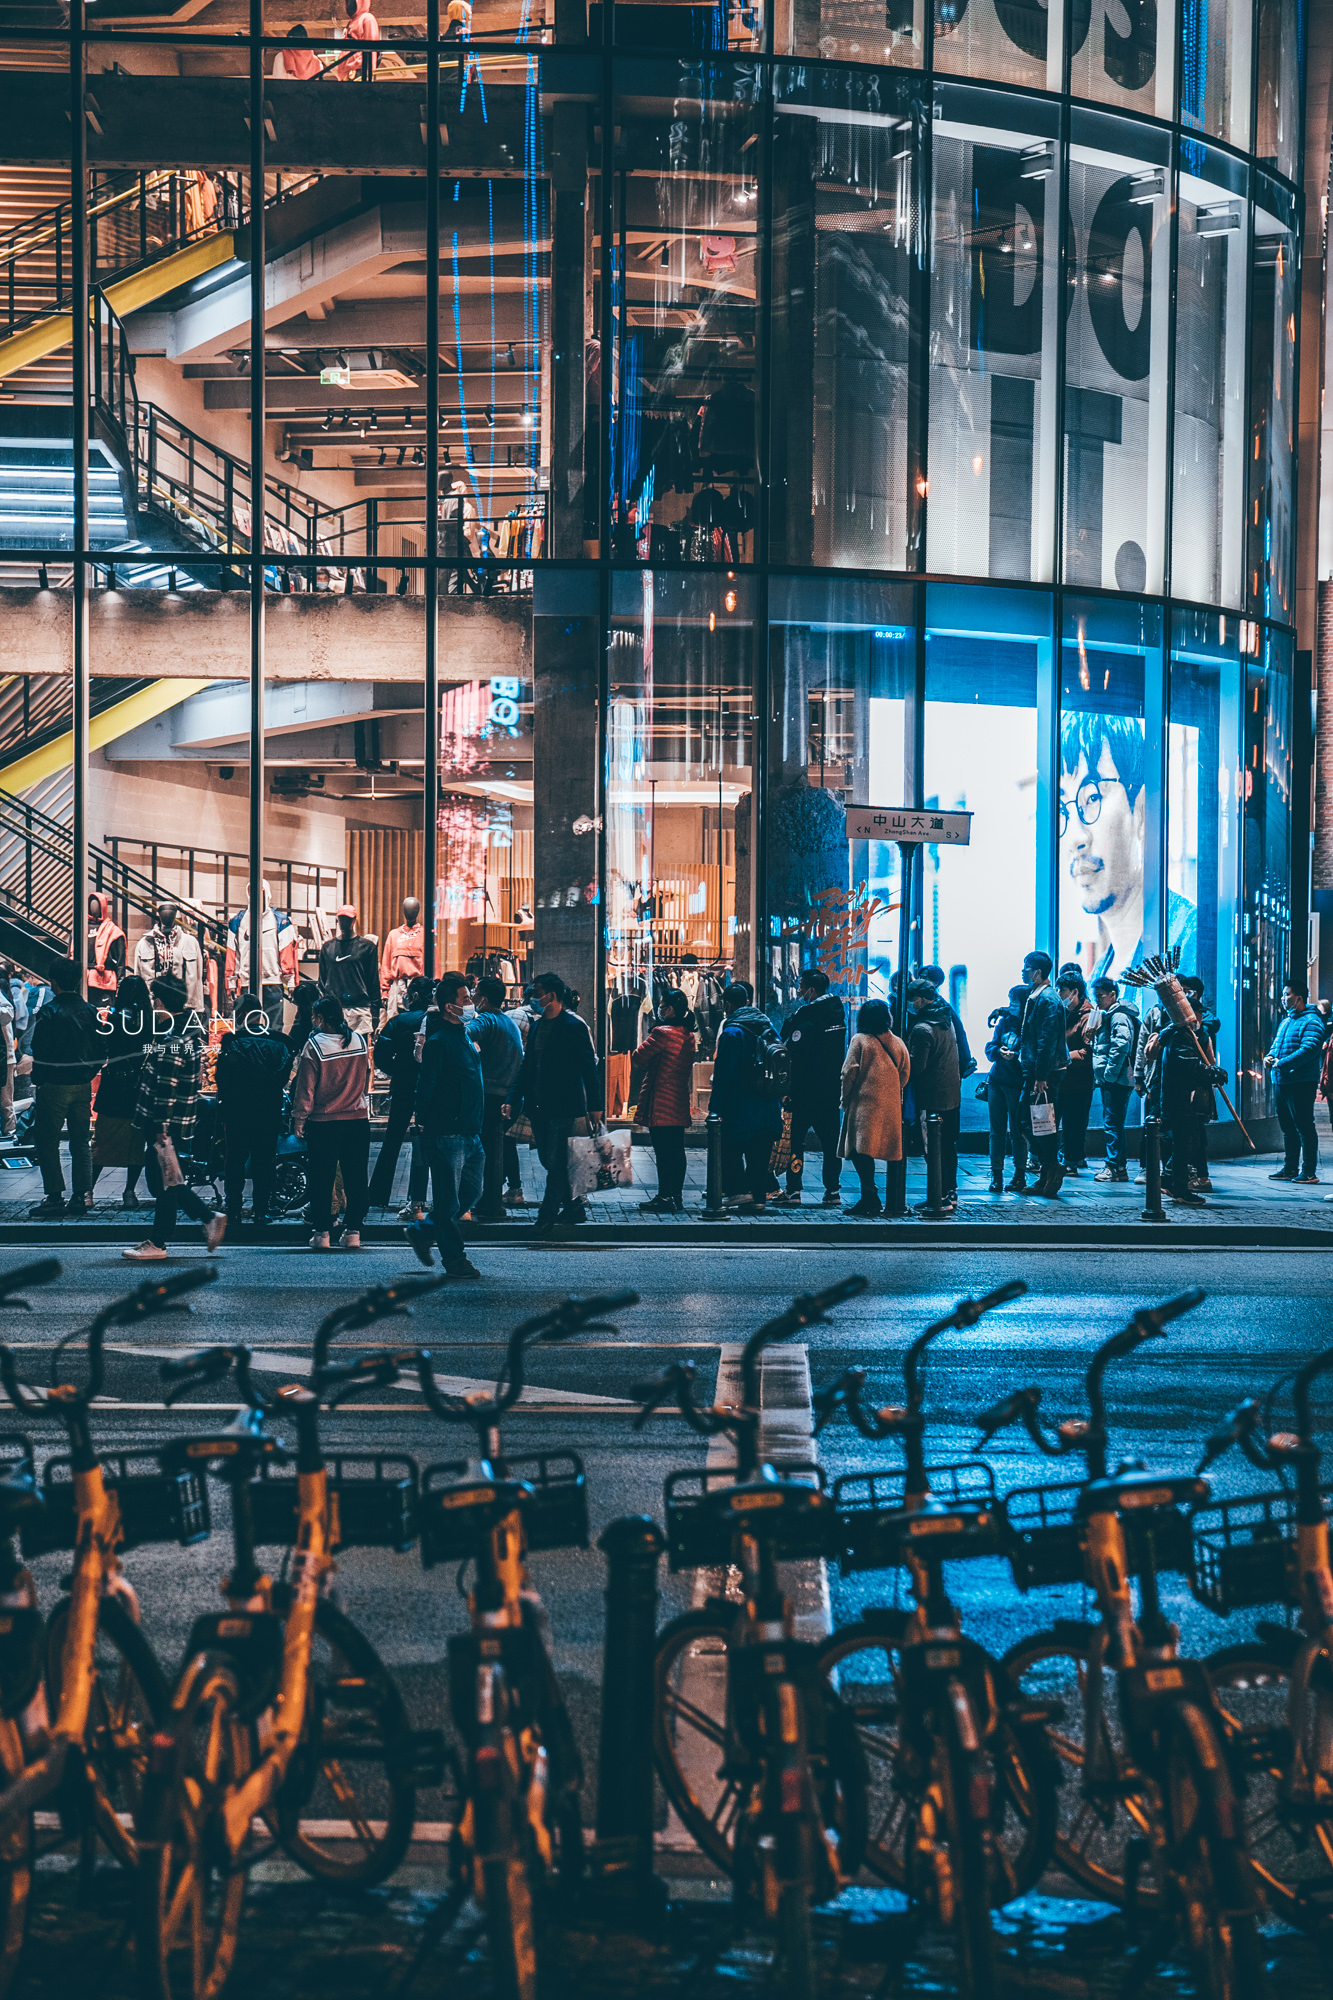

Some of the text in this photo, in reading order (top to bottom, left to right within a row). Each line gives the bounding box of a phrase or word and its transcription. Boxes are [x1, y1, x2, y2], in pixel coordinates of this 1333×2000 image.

[873, 814, 944, 830] 中山大道
[945, 831, 952, 839] S
[812, 881, 866, 907] 2021
